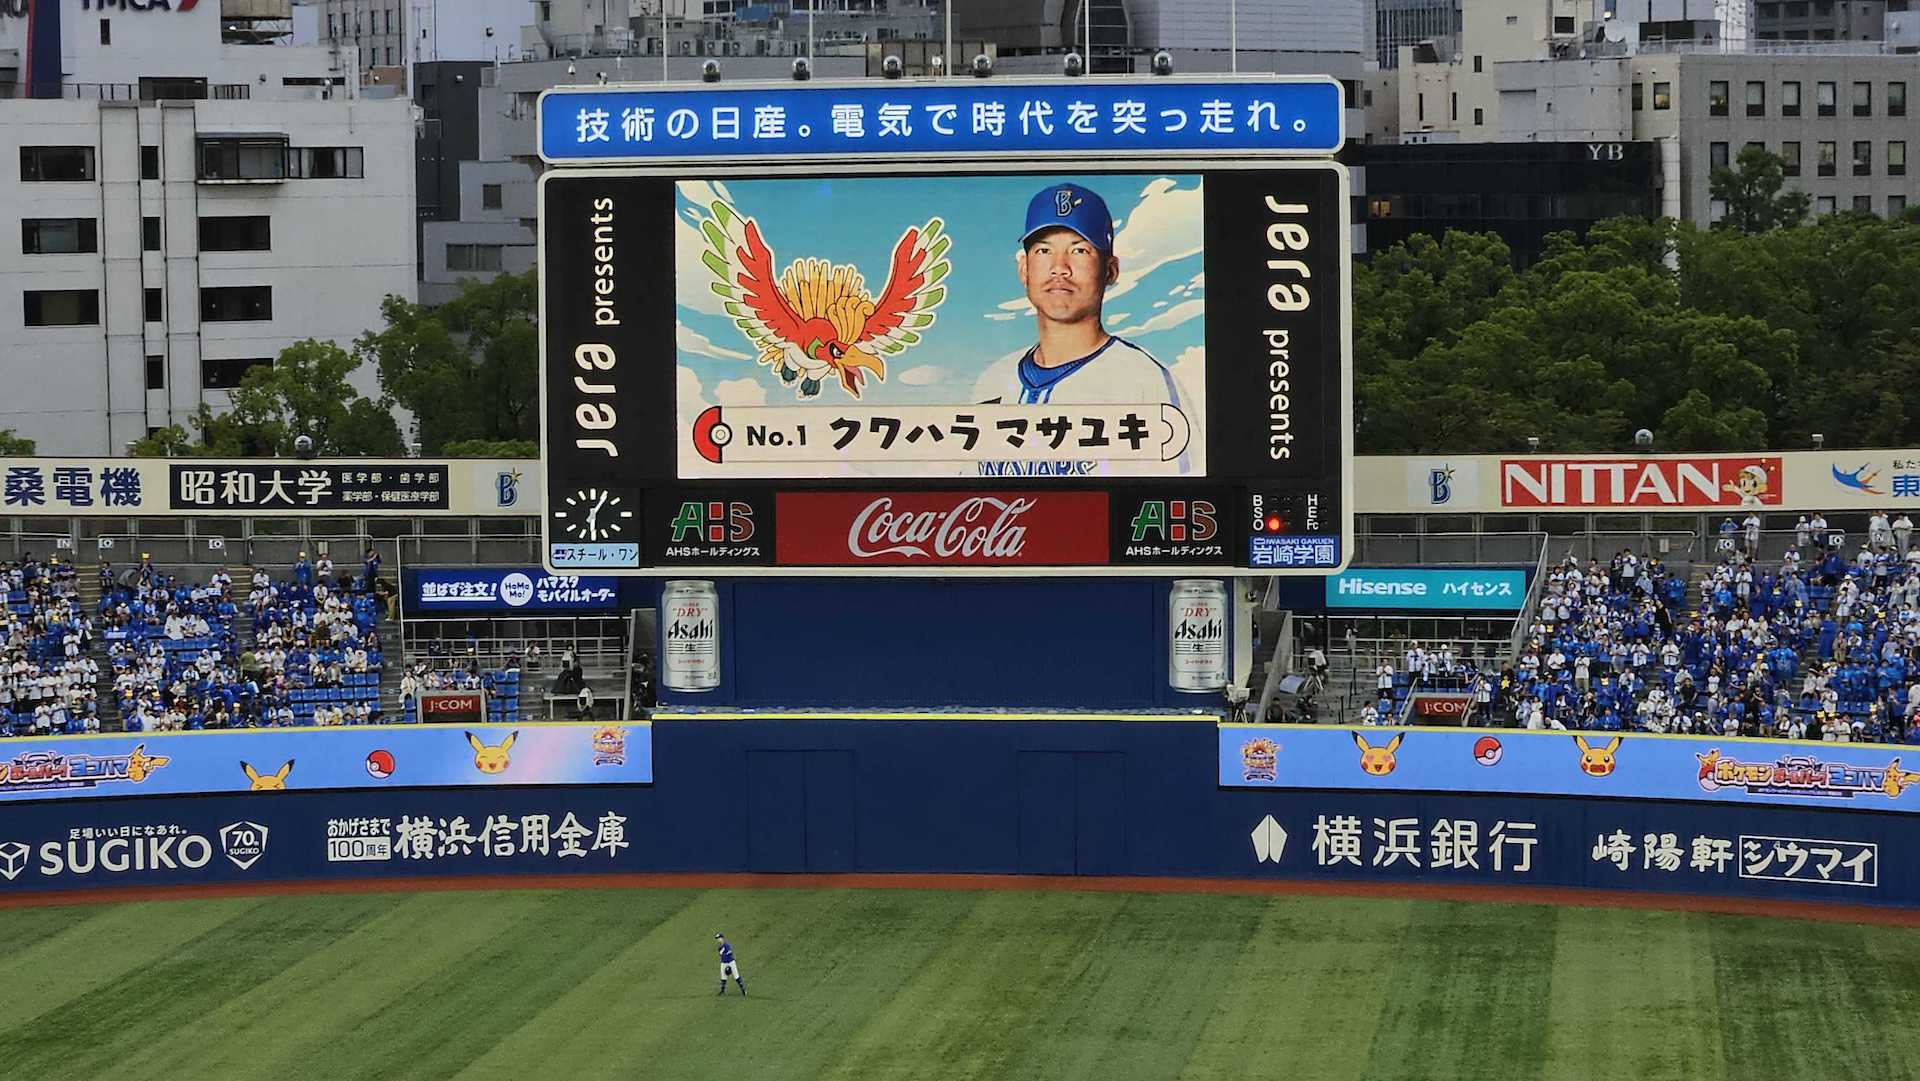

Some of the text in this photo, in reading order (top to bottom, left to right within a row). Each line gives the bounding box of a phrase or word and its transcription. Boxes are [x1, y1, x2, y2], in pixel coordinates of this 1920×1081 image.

[576, 100, 1309, 143] 技術の日産。電気で時代を突っ走れ。
[1587, 144, 1623, 160] YB
[590, 197, 620, 326] presents
[1262, 329, 1294, 460] presents
[746, 413, 1149, 451] No.1 クワハラ マサユキ
[4, 467, 142, 507] 桑電機
[180, 469, 333, 505] 昭和大学
[1504, 463, 1720, 504] NITTAN
[1892, 474, 1920, 497] 東
[1252, 494, 1264, 507] B
[1307, 493, 1318, 506] H
[1253, 507, 1264, 519] S
[1307, 506, 1318, 519] E
[848, 497, 1037, 558] Coca-Cola
[567, 548, 638, 560] スチール・ワン
[666, 547, 760, 557] AHSホールディングス
[1126, 546, 1223, 556] AHSホールディングス
[1252, 544, 1335, 565] 岩崎学園
[536, 576, 580, 589] ハマスタ
[1338, 578, 1512, 596] Hisense ハイセンス
[667, 619, 713, 640] Asahi
[1174, 619, 1222, 640] Asahi
[428, 698, 473, 713] J:COM
[327, 817, 391, 837] おかげさまで
[393, 811, 630, 859] 横浜信用金庫
[330, 839, 388, 858] 100周年
[1312, 814, 1538, 872] 横浜銀行
[40, 834, 213, 876] SUGIKO
[1592, 829, 1874, 882] 崎陽軒 シウマイ
